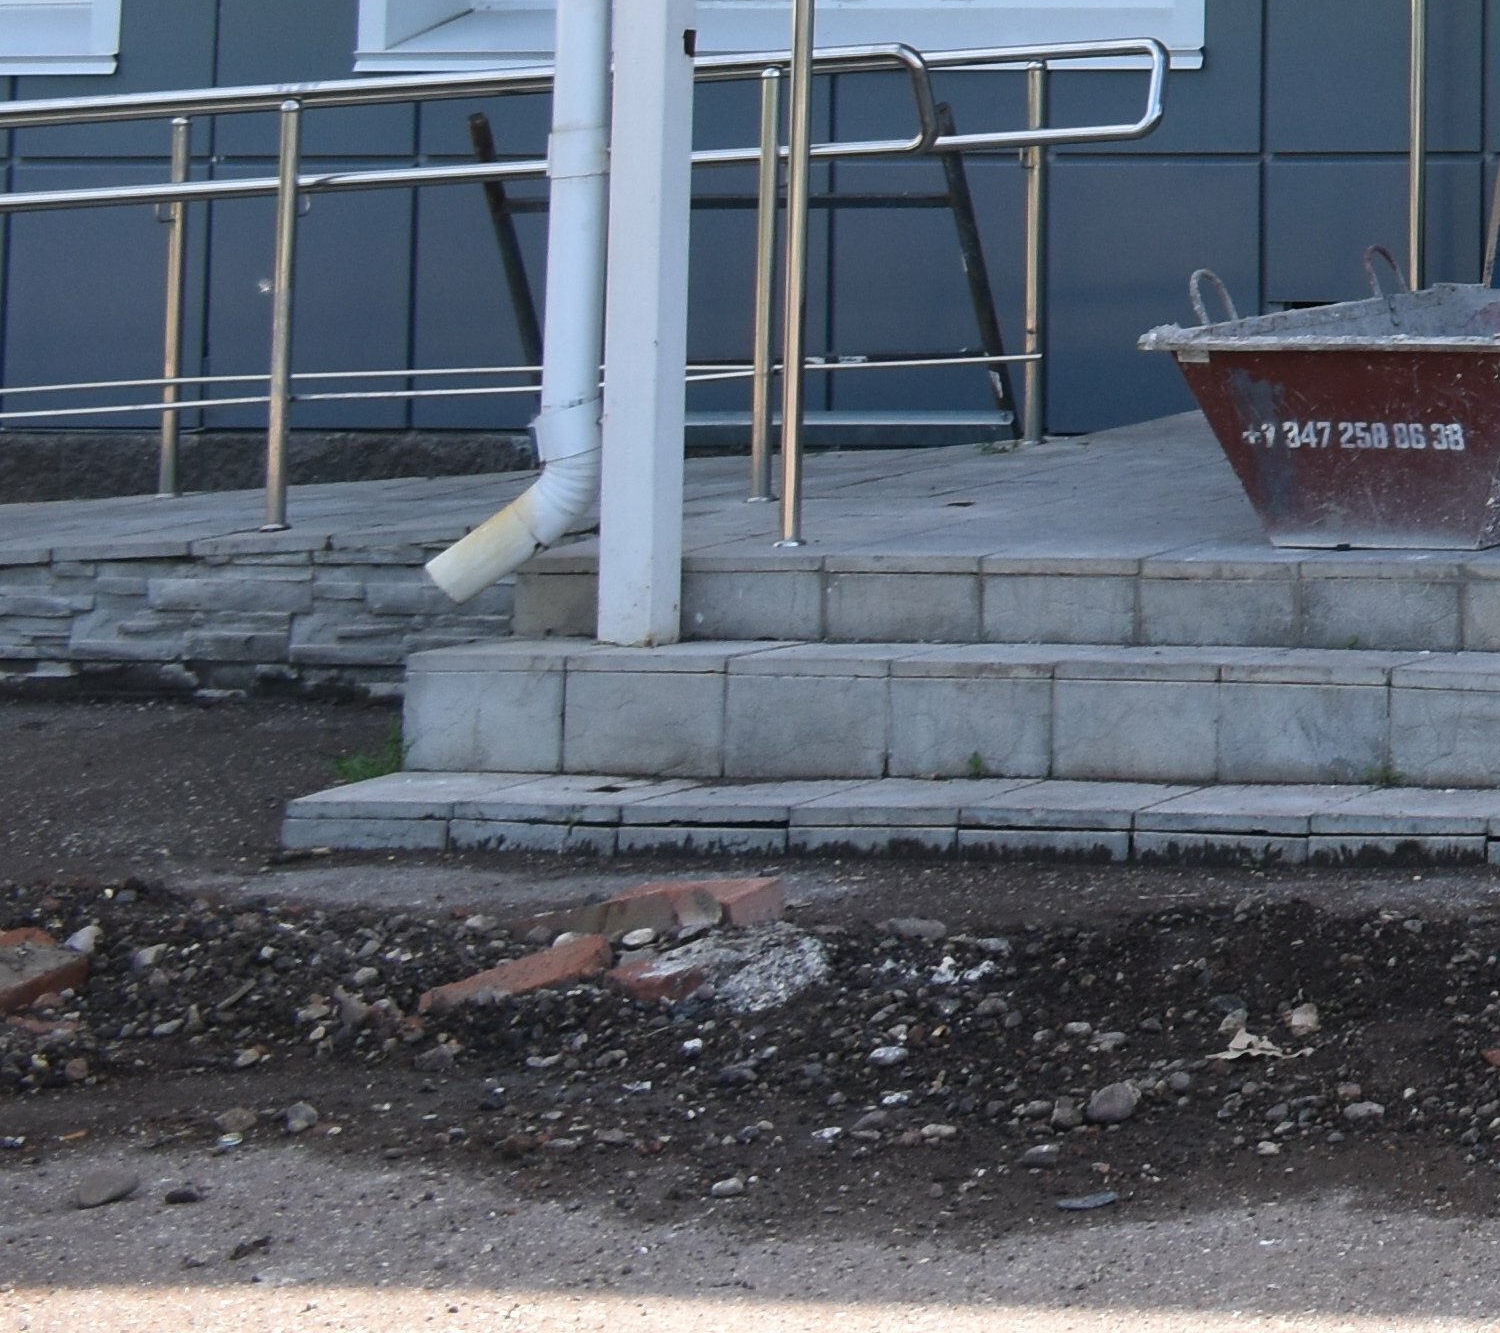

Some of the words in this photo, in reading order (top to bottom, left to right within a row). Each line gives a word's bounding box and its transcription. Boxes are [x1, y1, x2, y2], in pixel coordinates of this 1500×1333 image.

[1282, 421, 1331, 449] 347
[1338, 421, 1389, 449] 258
[1430, 423, 1465, 451] 38
